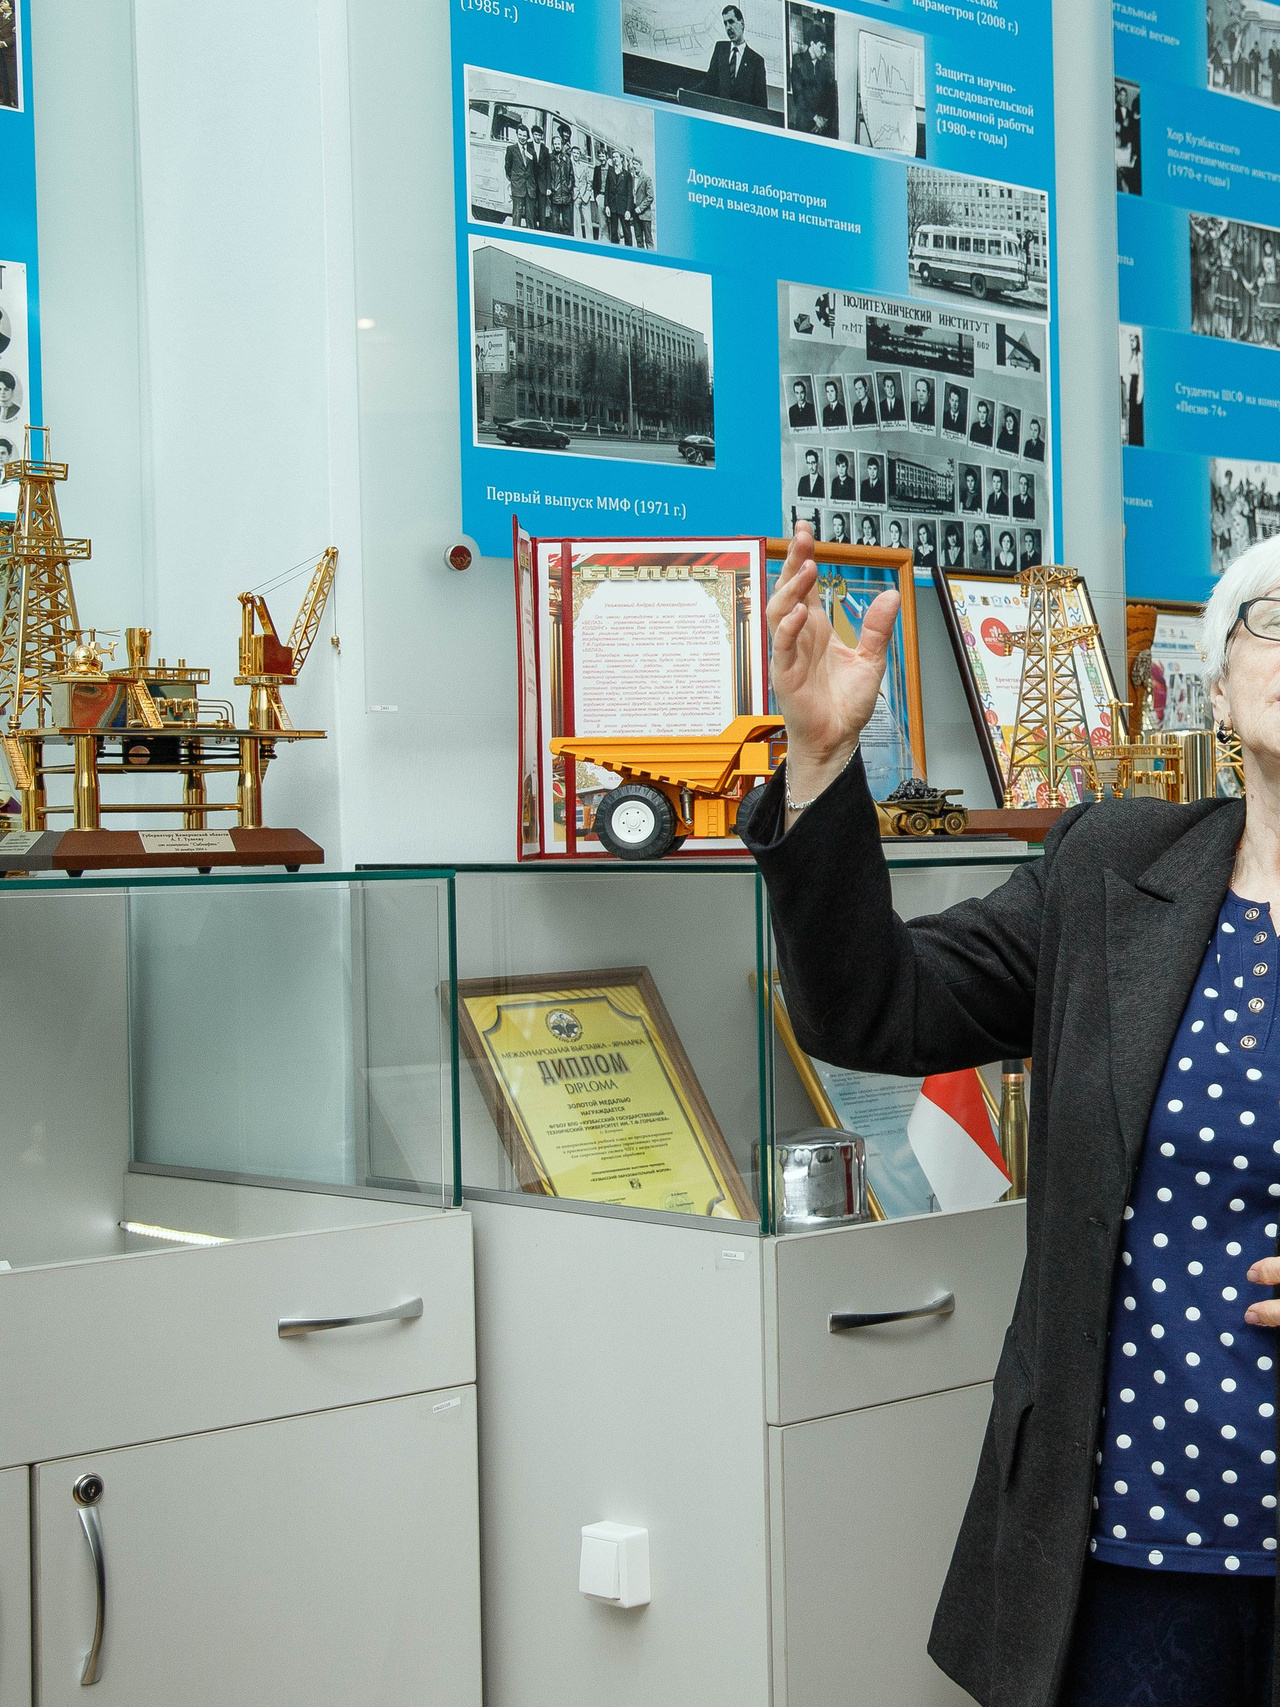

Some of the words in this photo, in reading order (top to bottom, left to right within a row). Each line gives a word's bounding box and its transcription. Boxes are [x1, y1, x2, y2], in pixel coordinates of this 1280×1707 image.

[912, 0, 974, 20] параметров
[977, 11, 1006, 29] (2008
[1008, 21, 1019, 36] г.)
[935, 63, 975, 84] Защита
[977, 76, 1016, 94] научно-
[936, 84, 1034, 117] исследовательской
[936, 103, 995, 125] дипломной
[997, 118, 1034, 135] работы
[937, 118, 976, 139] (1980-е
[979, 132, 1008, 149] годы)
[1167, 127, 1184, 144] Хор
[687, 168, 749, 193] Дорожная
[752, 184, 827, 208] лаборатория
[688, 191, 725, 210] перед
[727, 198, 779, 218] выездом
[782, 210, 796, 222] на
[799, 212, 862, 234] испытания
[843, 294, 932, 323] ПОЛИТЕХНИЧЕСКИЙ
[939, 313, 990, 334] ИНСТИТУТ
[1175, 382, 1220, 400] Студенты
[486, 485, 541, 506] Первый
[544, 494, 594, 511] выпуск
[596, 496, 631, 512] ММФ
[634, 499, 670, 516] (1971
[673, 503, 687, 520] г.)
[580, 565, 719, 581] БЕЛАЗ
[501, 1045, 571, 1059] МЕЖДУНАРОДНАЯ
[571, 1042, 607, 1053] ВЫСТАВКА
[612, 1038, 646, 1048] ЯРМАРКА
[537, 1052, 630, 1085] ДИПЛОМ
[565, 1079, 619, 1095] DIPLOMA
[567, 1098, 599, 1110] ЗОЛОТОЙ
[599, 1097, 632, 1107] МЕДАЛЬЮ
[580, 1106, 625, 1117] НАГРАЖДАЕТСЯ
